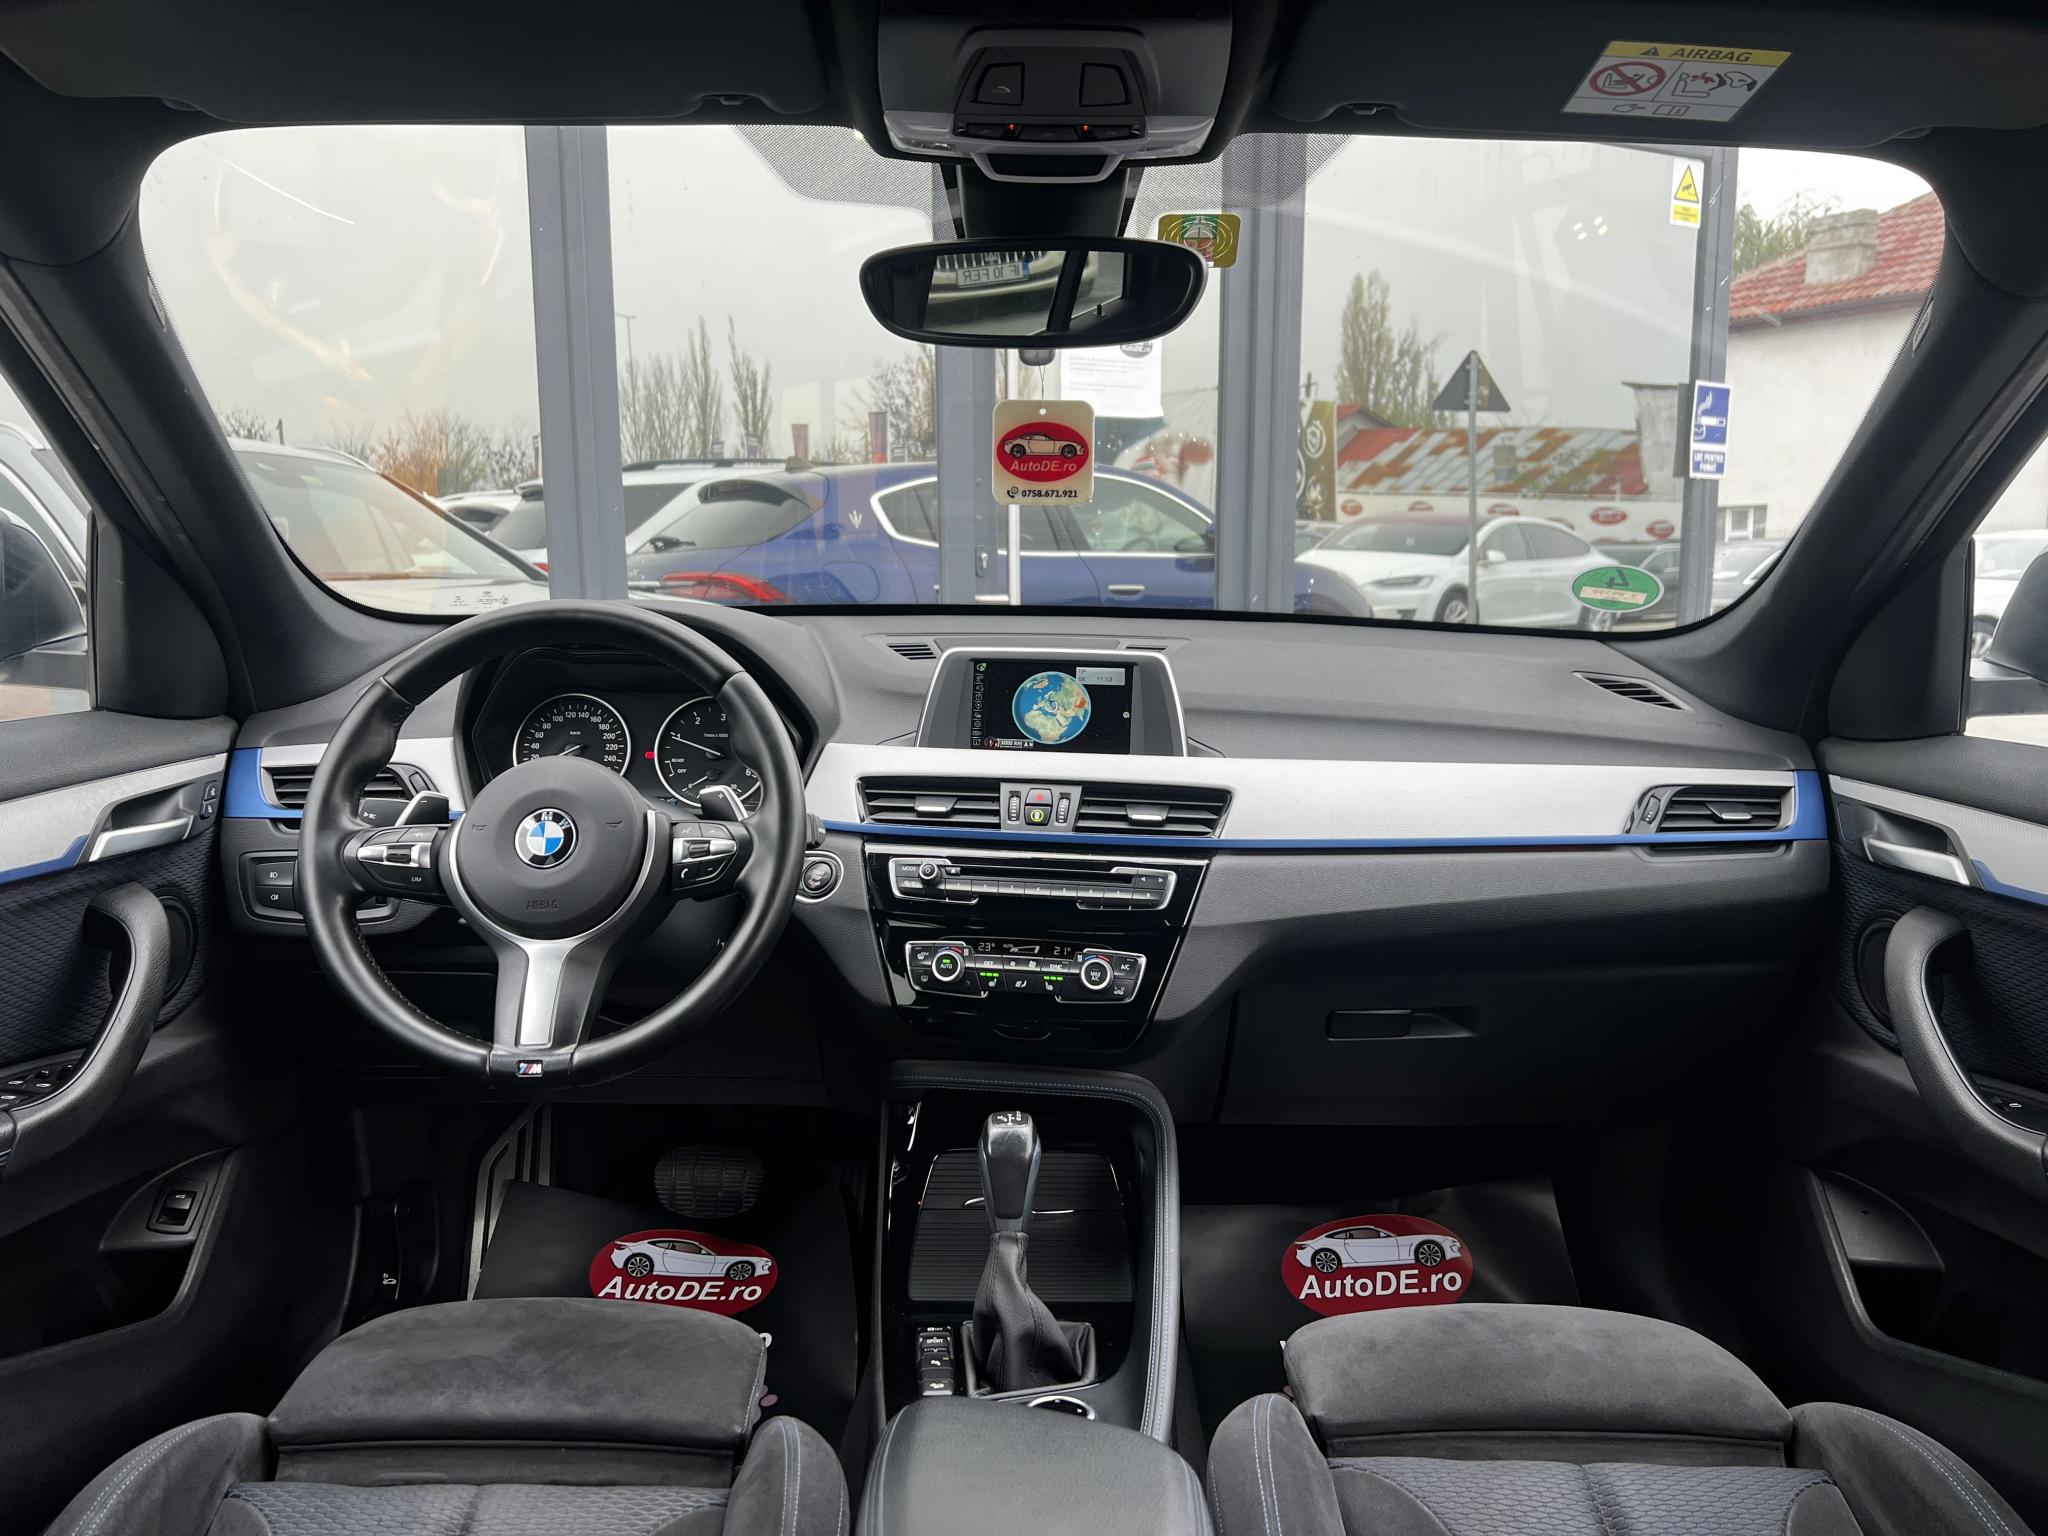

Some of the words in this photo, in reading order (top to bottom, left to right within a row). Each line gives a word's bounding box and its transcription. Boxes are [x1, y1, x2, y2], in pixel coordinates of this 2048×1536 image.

[1671, 48, 1752, 63] AIRBAG
[1010, 460, 1076, 472] AutoDE.ro
[1021, 489, 1078, 498] 0758.671.921
[694, 716, 701, 724] 2
[720, 713, 726, 721] 3
[535, 731, 544, 739] 60
[602, 732, 615, 740] 200
[530, 742, 539, 750] 40
[605, 743, 617, 751] 220
[603, 754, 616, 762] 240
[745, 768, 752, 776] 6
[522, 811, 571, 831] BMW
[526, 900, 560, 910] AIRBAG
[598, 1276, 763, 1301] AutoDE.ro
[1299, 1269, 1463, 1300] AutoDE.ro
